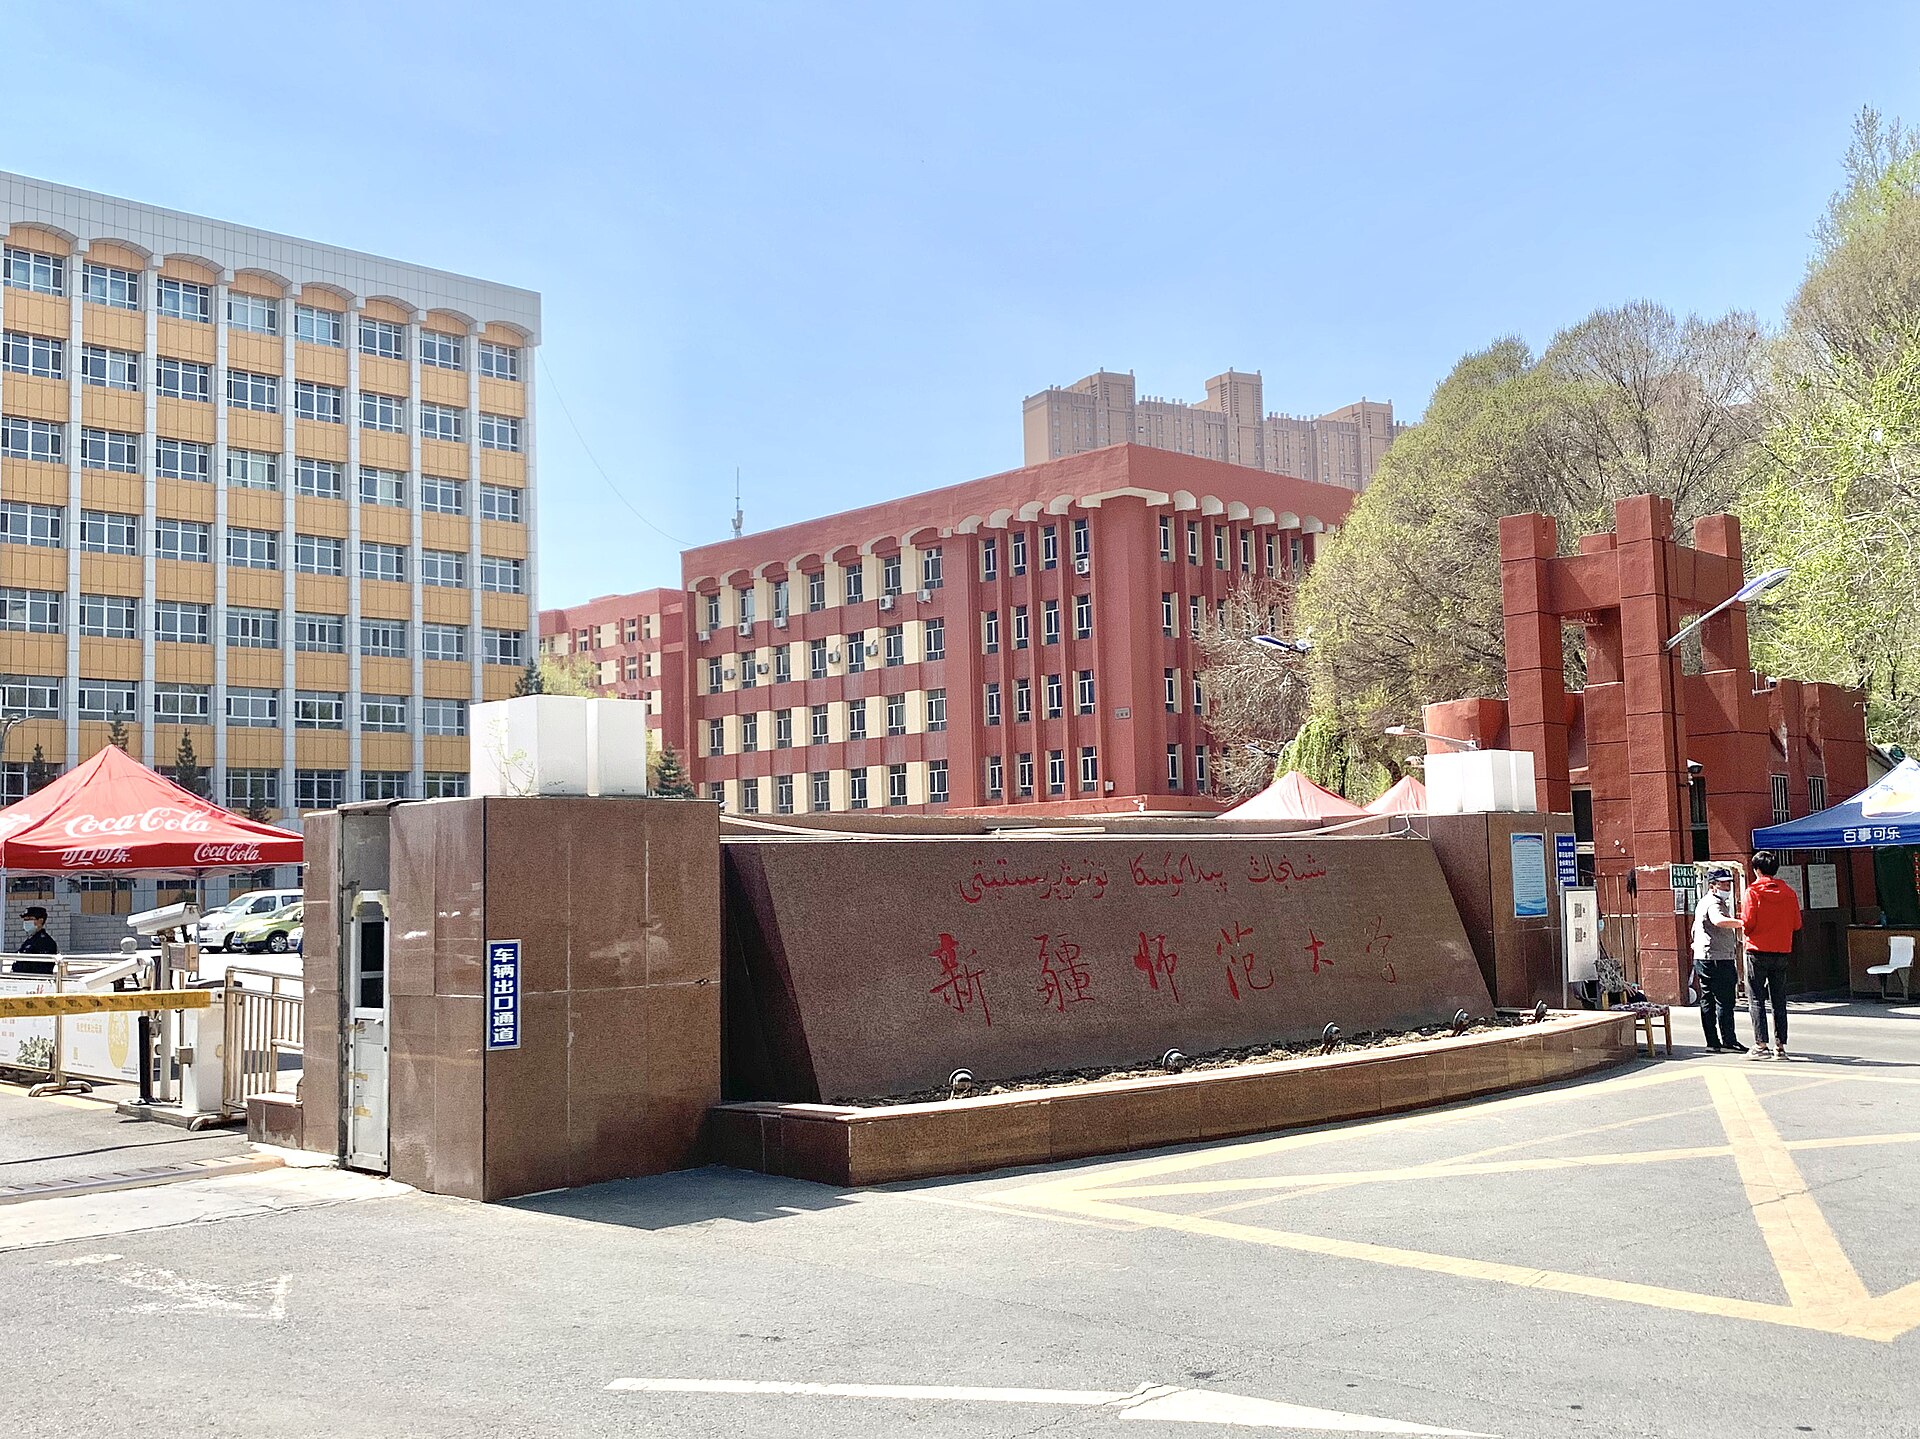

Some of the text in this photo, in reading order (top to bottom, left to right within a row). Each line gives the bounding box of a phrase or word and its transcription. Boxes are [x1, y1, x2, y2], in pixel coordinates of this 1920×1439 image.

[64, 807, 210, 838] Coca-Cola
[1842, 826, 1901, 843] 百事可乐
[61, 848, 131, 866] 可口可乐
[194, 842, 260, 863] Coca-Cola
[930, 915, 1397, 1027] 新疆师范大学
[493, 947, 515, 1043] 车辆出口通道
